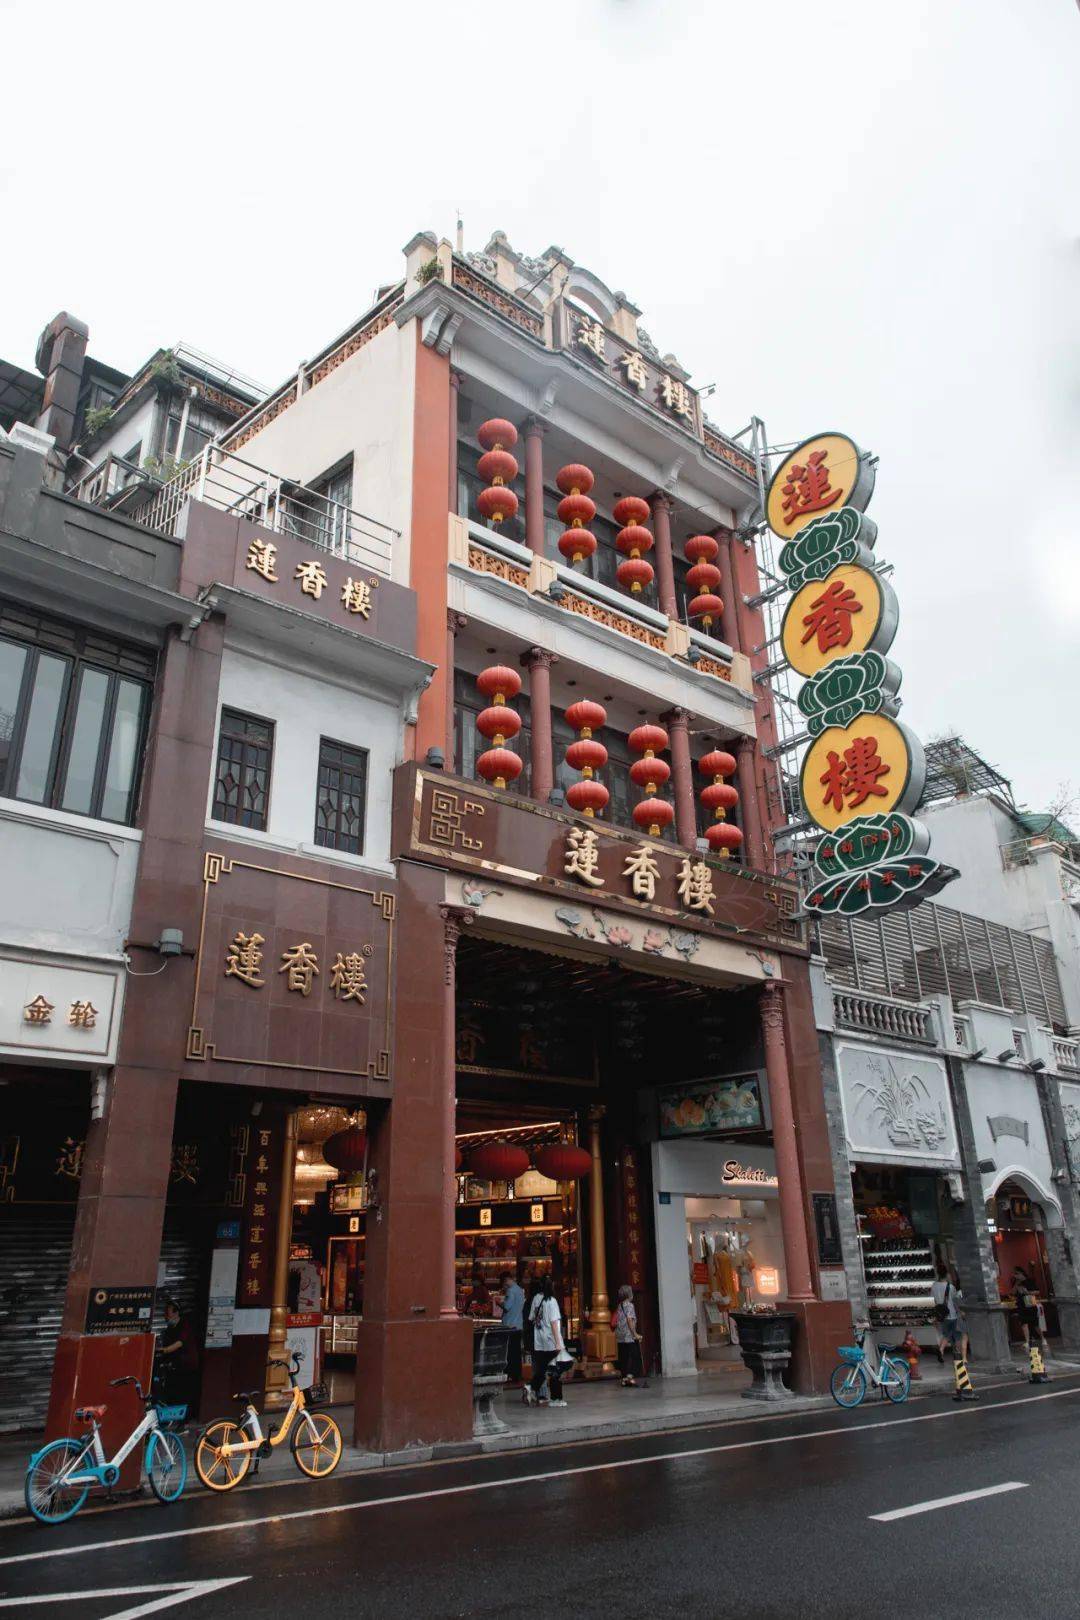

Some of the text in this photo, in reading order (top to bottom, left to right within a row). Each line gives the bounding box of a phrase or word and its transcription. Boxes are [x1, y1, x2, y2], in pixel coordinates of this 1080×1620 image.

[577, 317, 695, 422] 蓮香樓
[246, 539, 373, 620] 蓮香樓
[781, 450, 890, 812] 蓮香樓
[564, 826, 716, 915] 蓮香樓
[225, 931, 369, 1005] 蓮香樓
[23, 994, 99, 1029] 金轮
